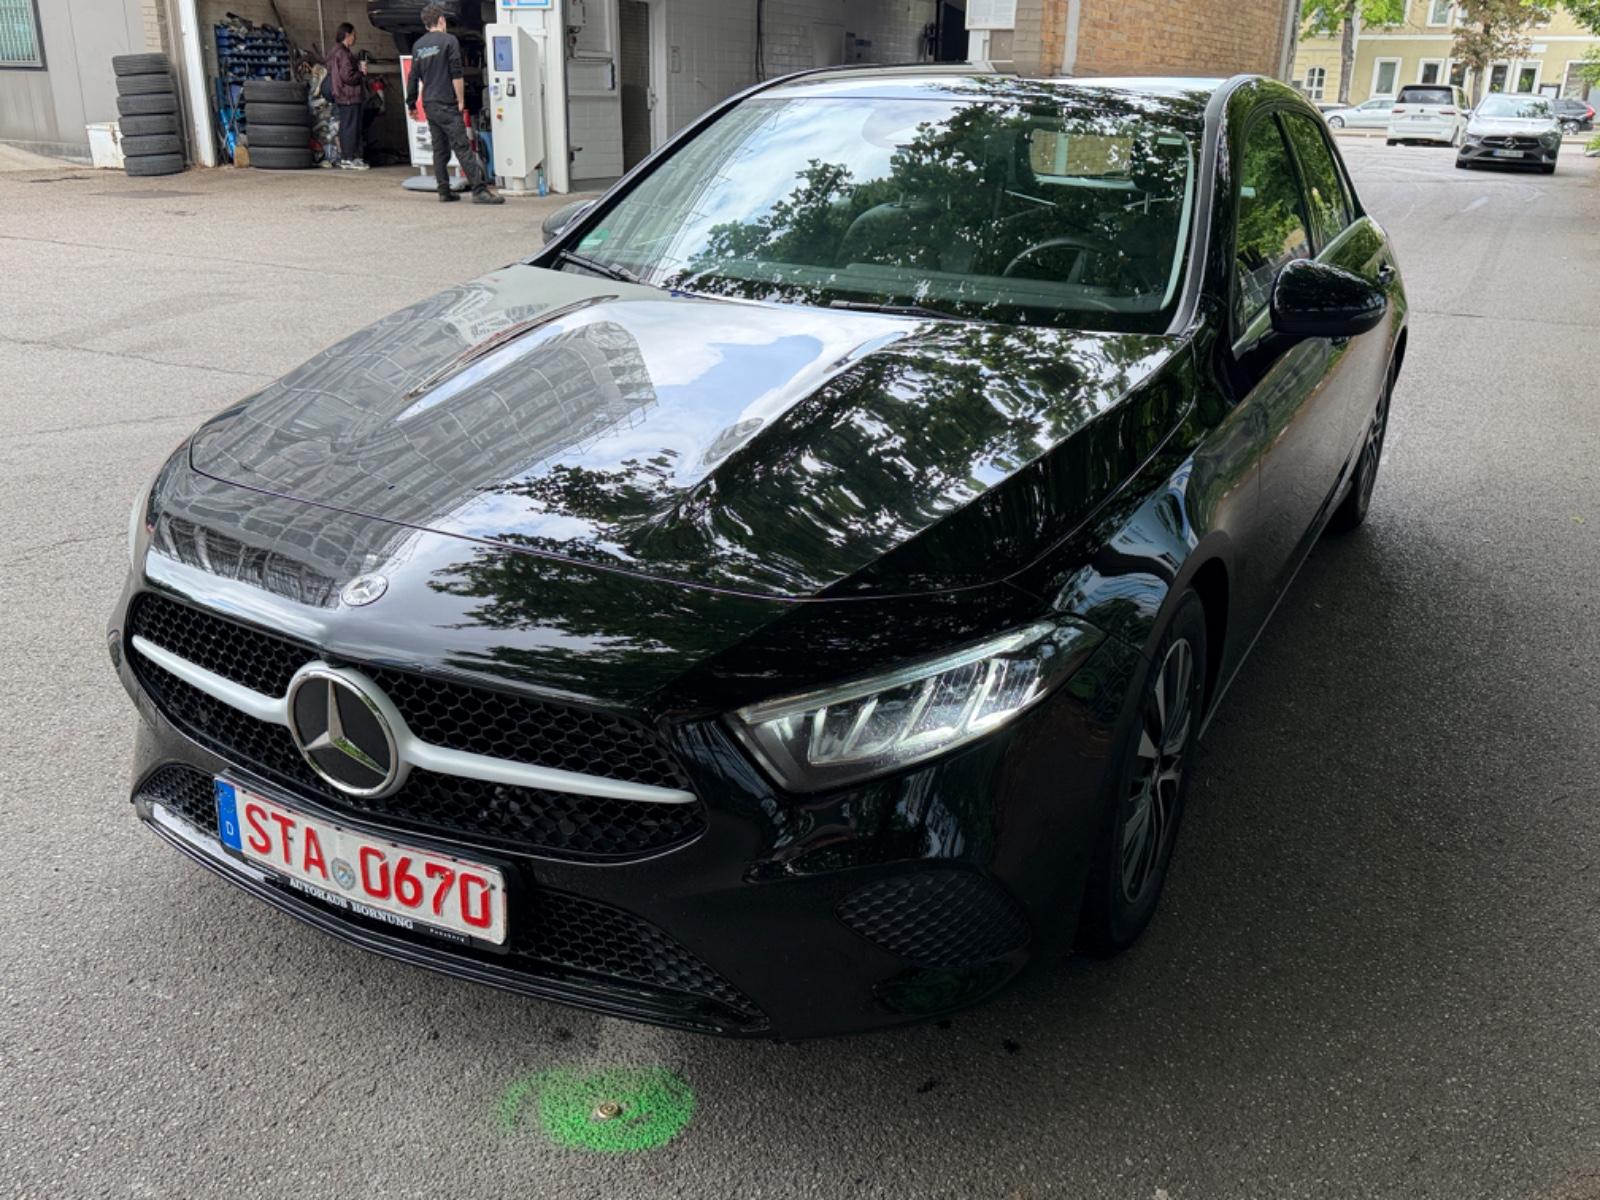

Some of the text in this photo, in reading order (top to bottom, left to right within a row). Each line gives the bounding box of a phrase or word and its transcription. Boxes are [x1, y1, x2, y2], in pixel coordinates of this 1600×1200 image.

[225, 820, 234, 836] D
[245, 803, 492, 929] STA 0670
